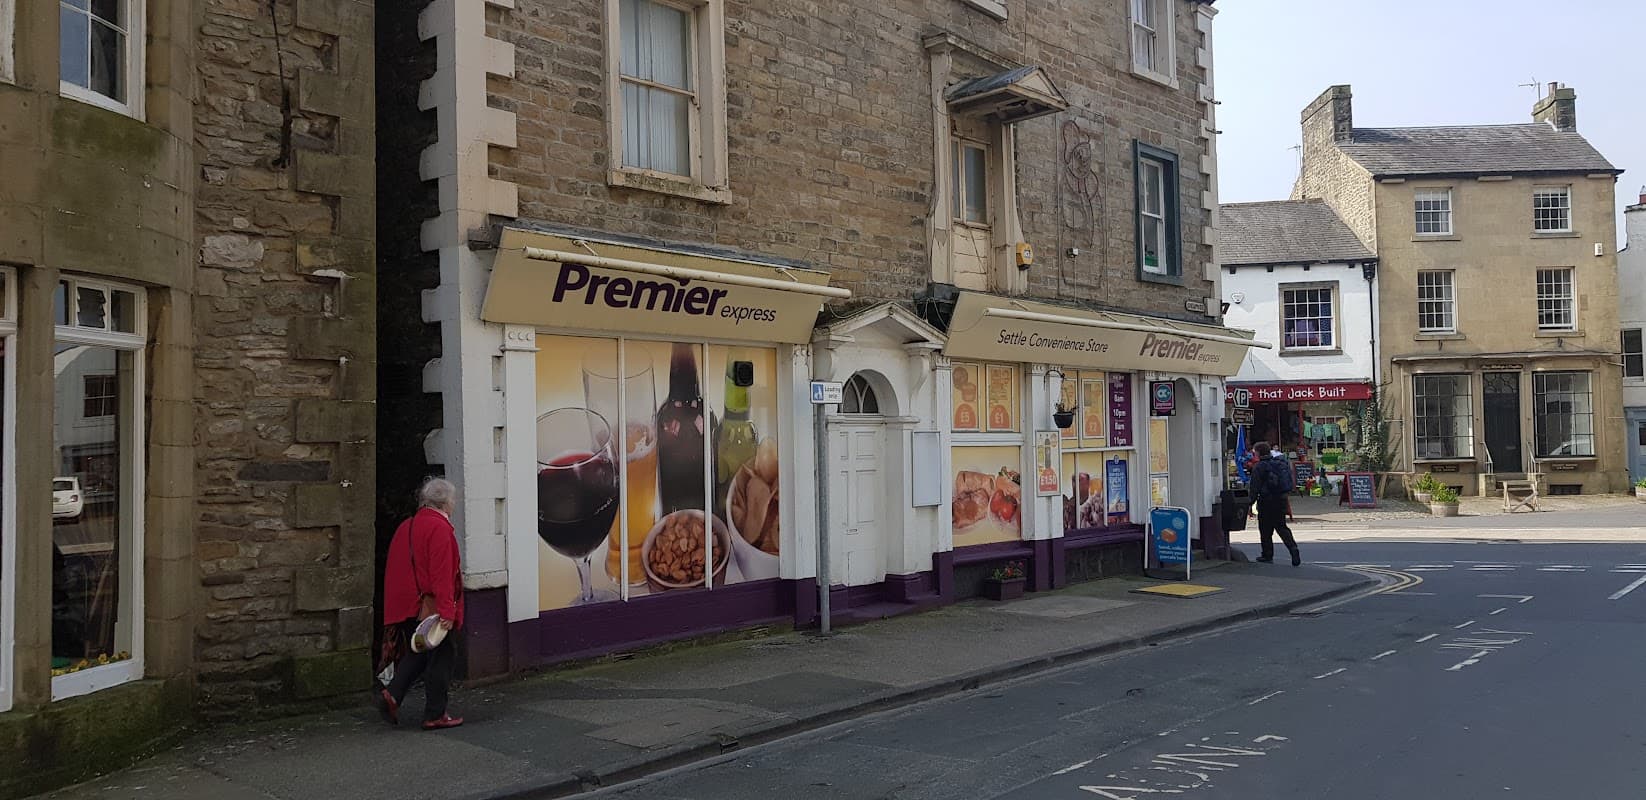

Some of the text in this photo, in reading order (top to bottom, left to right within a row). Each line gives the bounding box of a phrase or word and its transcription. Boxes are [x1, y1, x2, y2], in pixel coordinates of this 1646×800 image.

[552, 263, 777, 325] Premier express
[997, 328, 1109, 353] Settle Convenience Store
[1139, 332, 1221, 363] Premier express
[1240, 392, 1247, 405] P
[1258, 386, 1283, 399] that
[1288, 387, 1314, 399] Jack
[1319, 386, 1346, 397] Built
